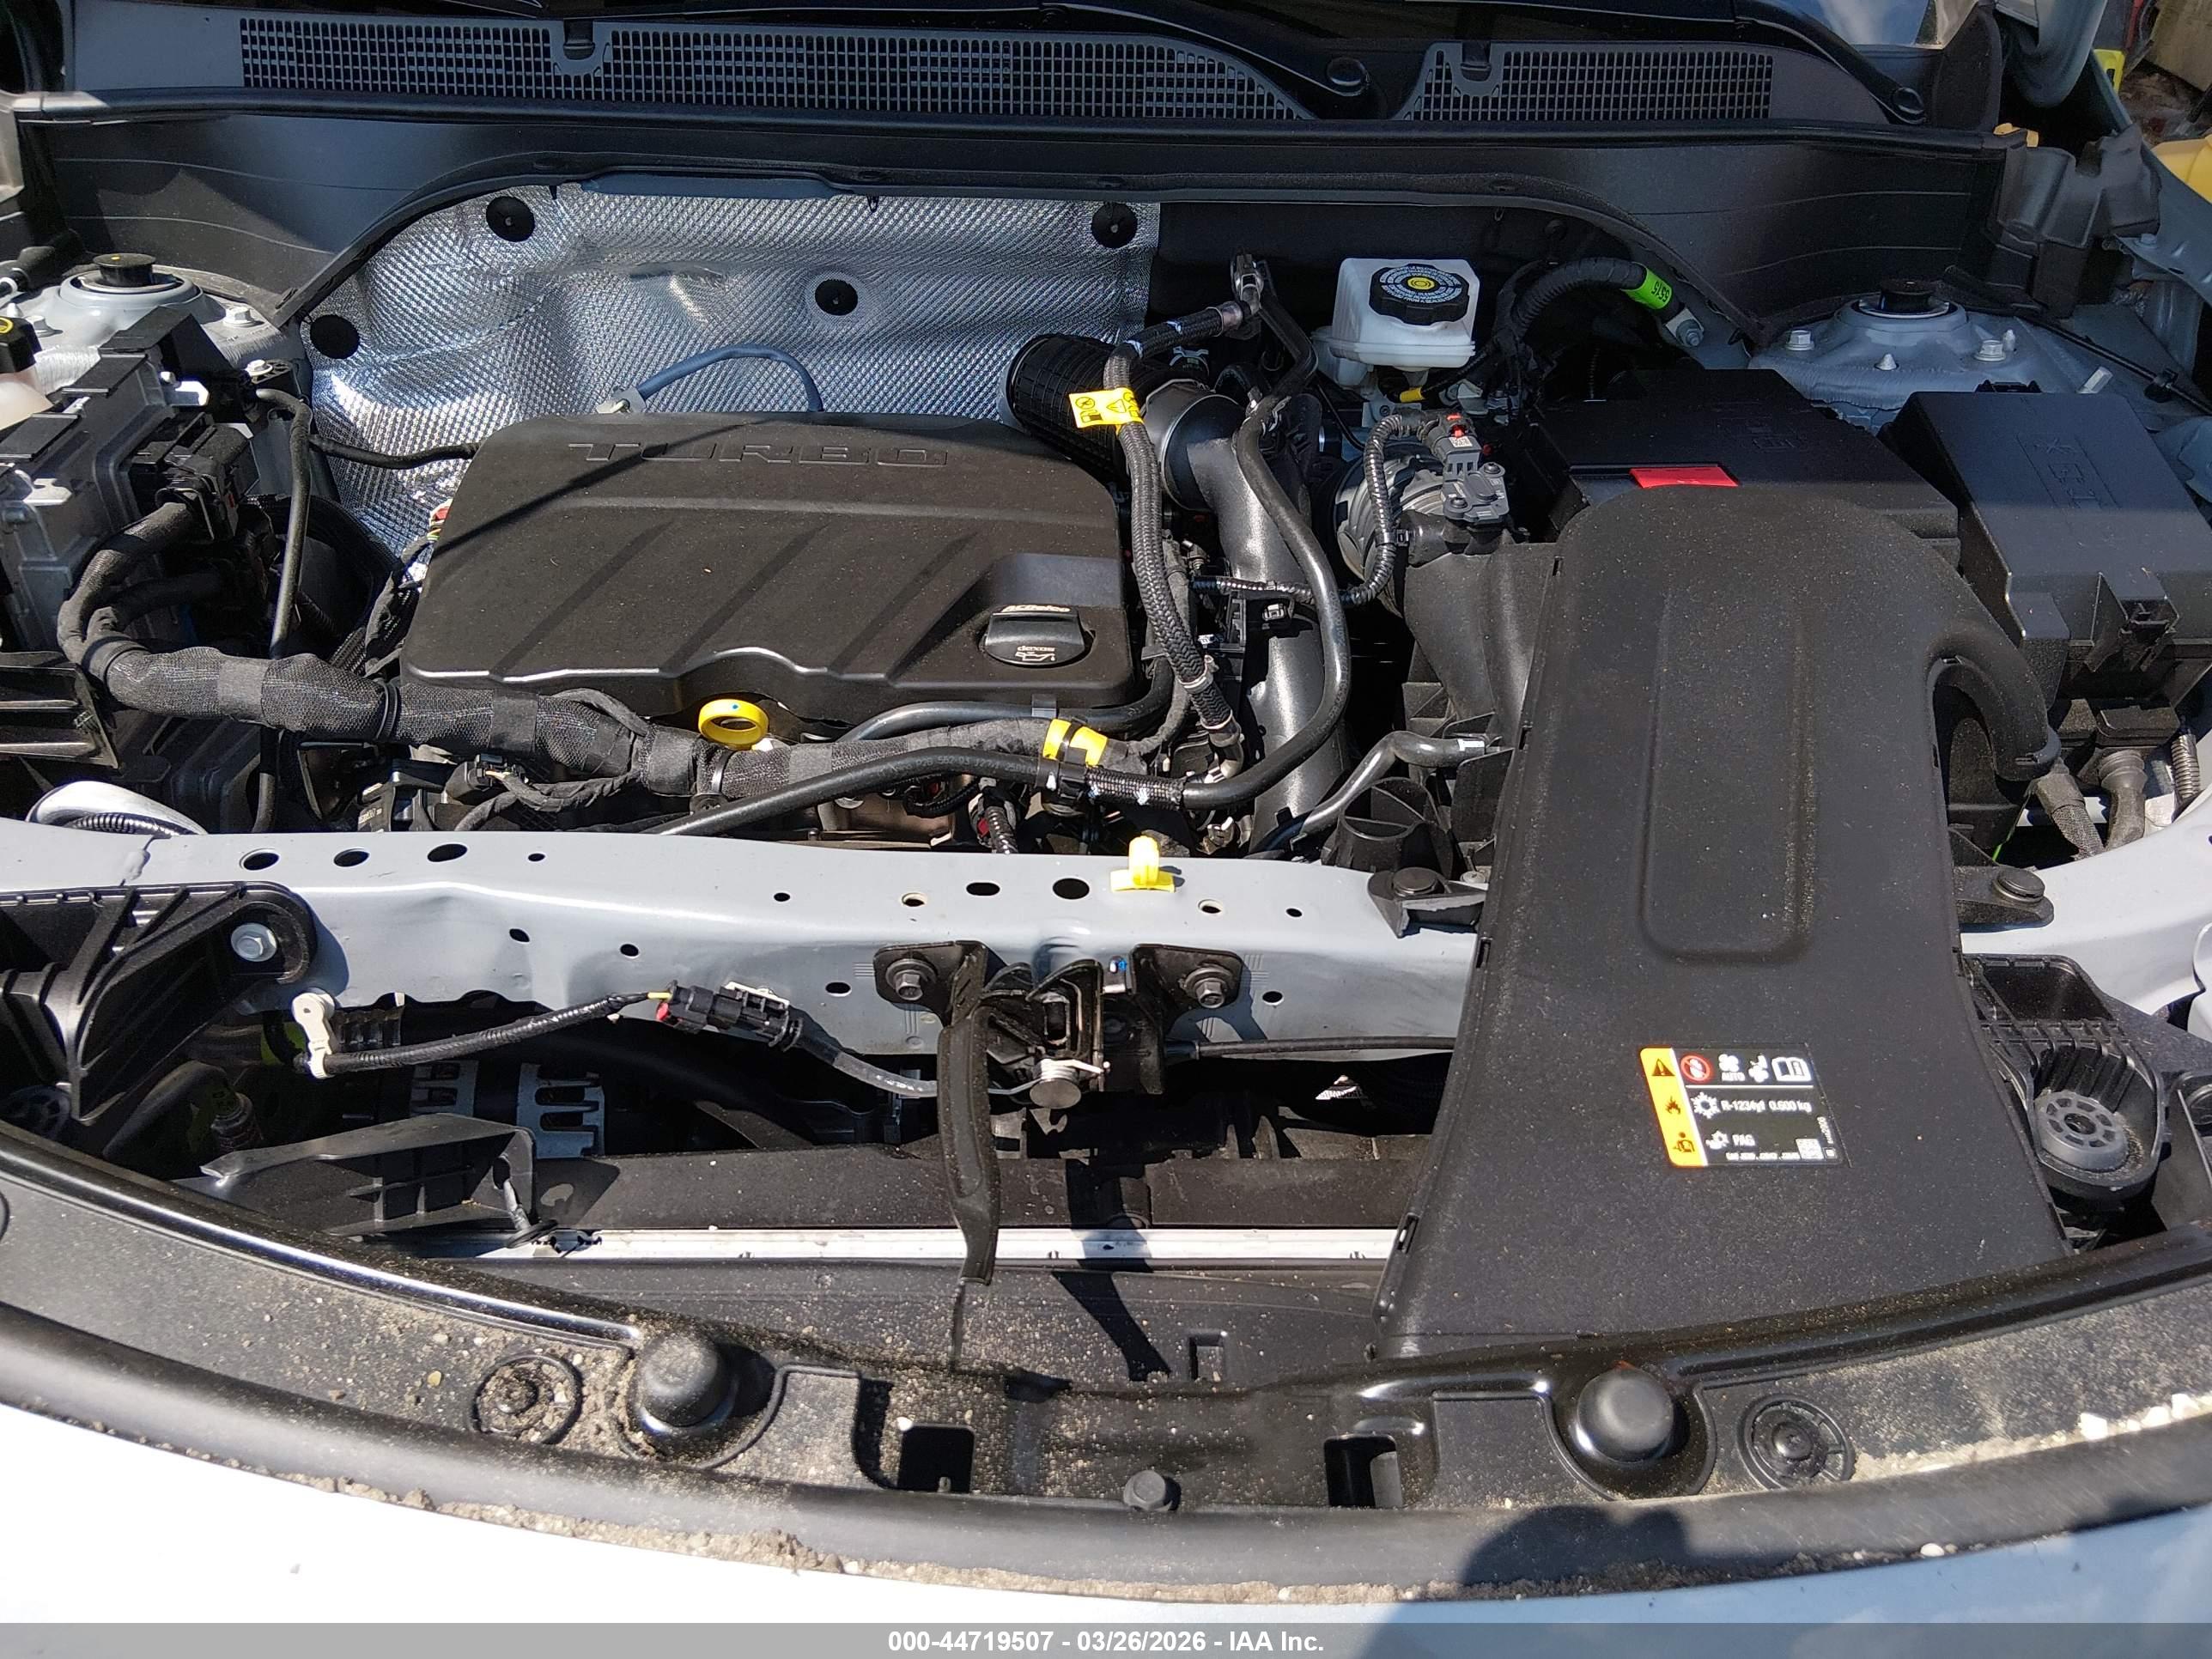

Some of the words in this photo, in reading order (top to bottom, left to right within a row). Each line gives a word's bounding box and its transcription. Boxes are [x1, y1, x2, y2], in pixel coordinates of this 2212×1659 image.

[568, 442, 948, 468] TURBO
[1721, 1072, 1746, 1082] AUTO
[1796, 1099, 1813, 1115] kg
